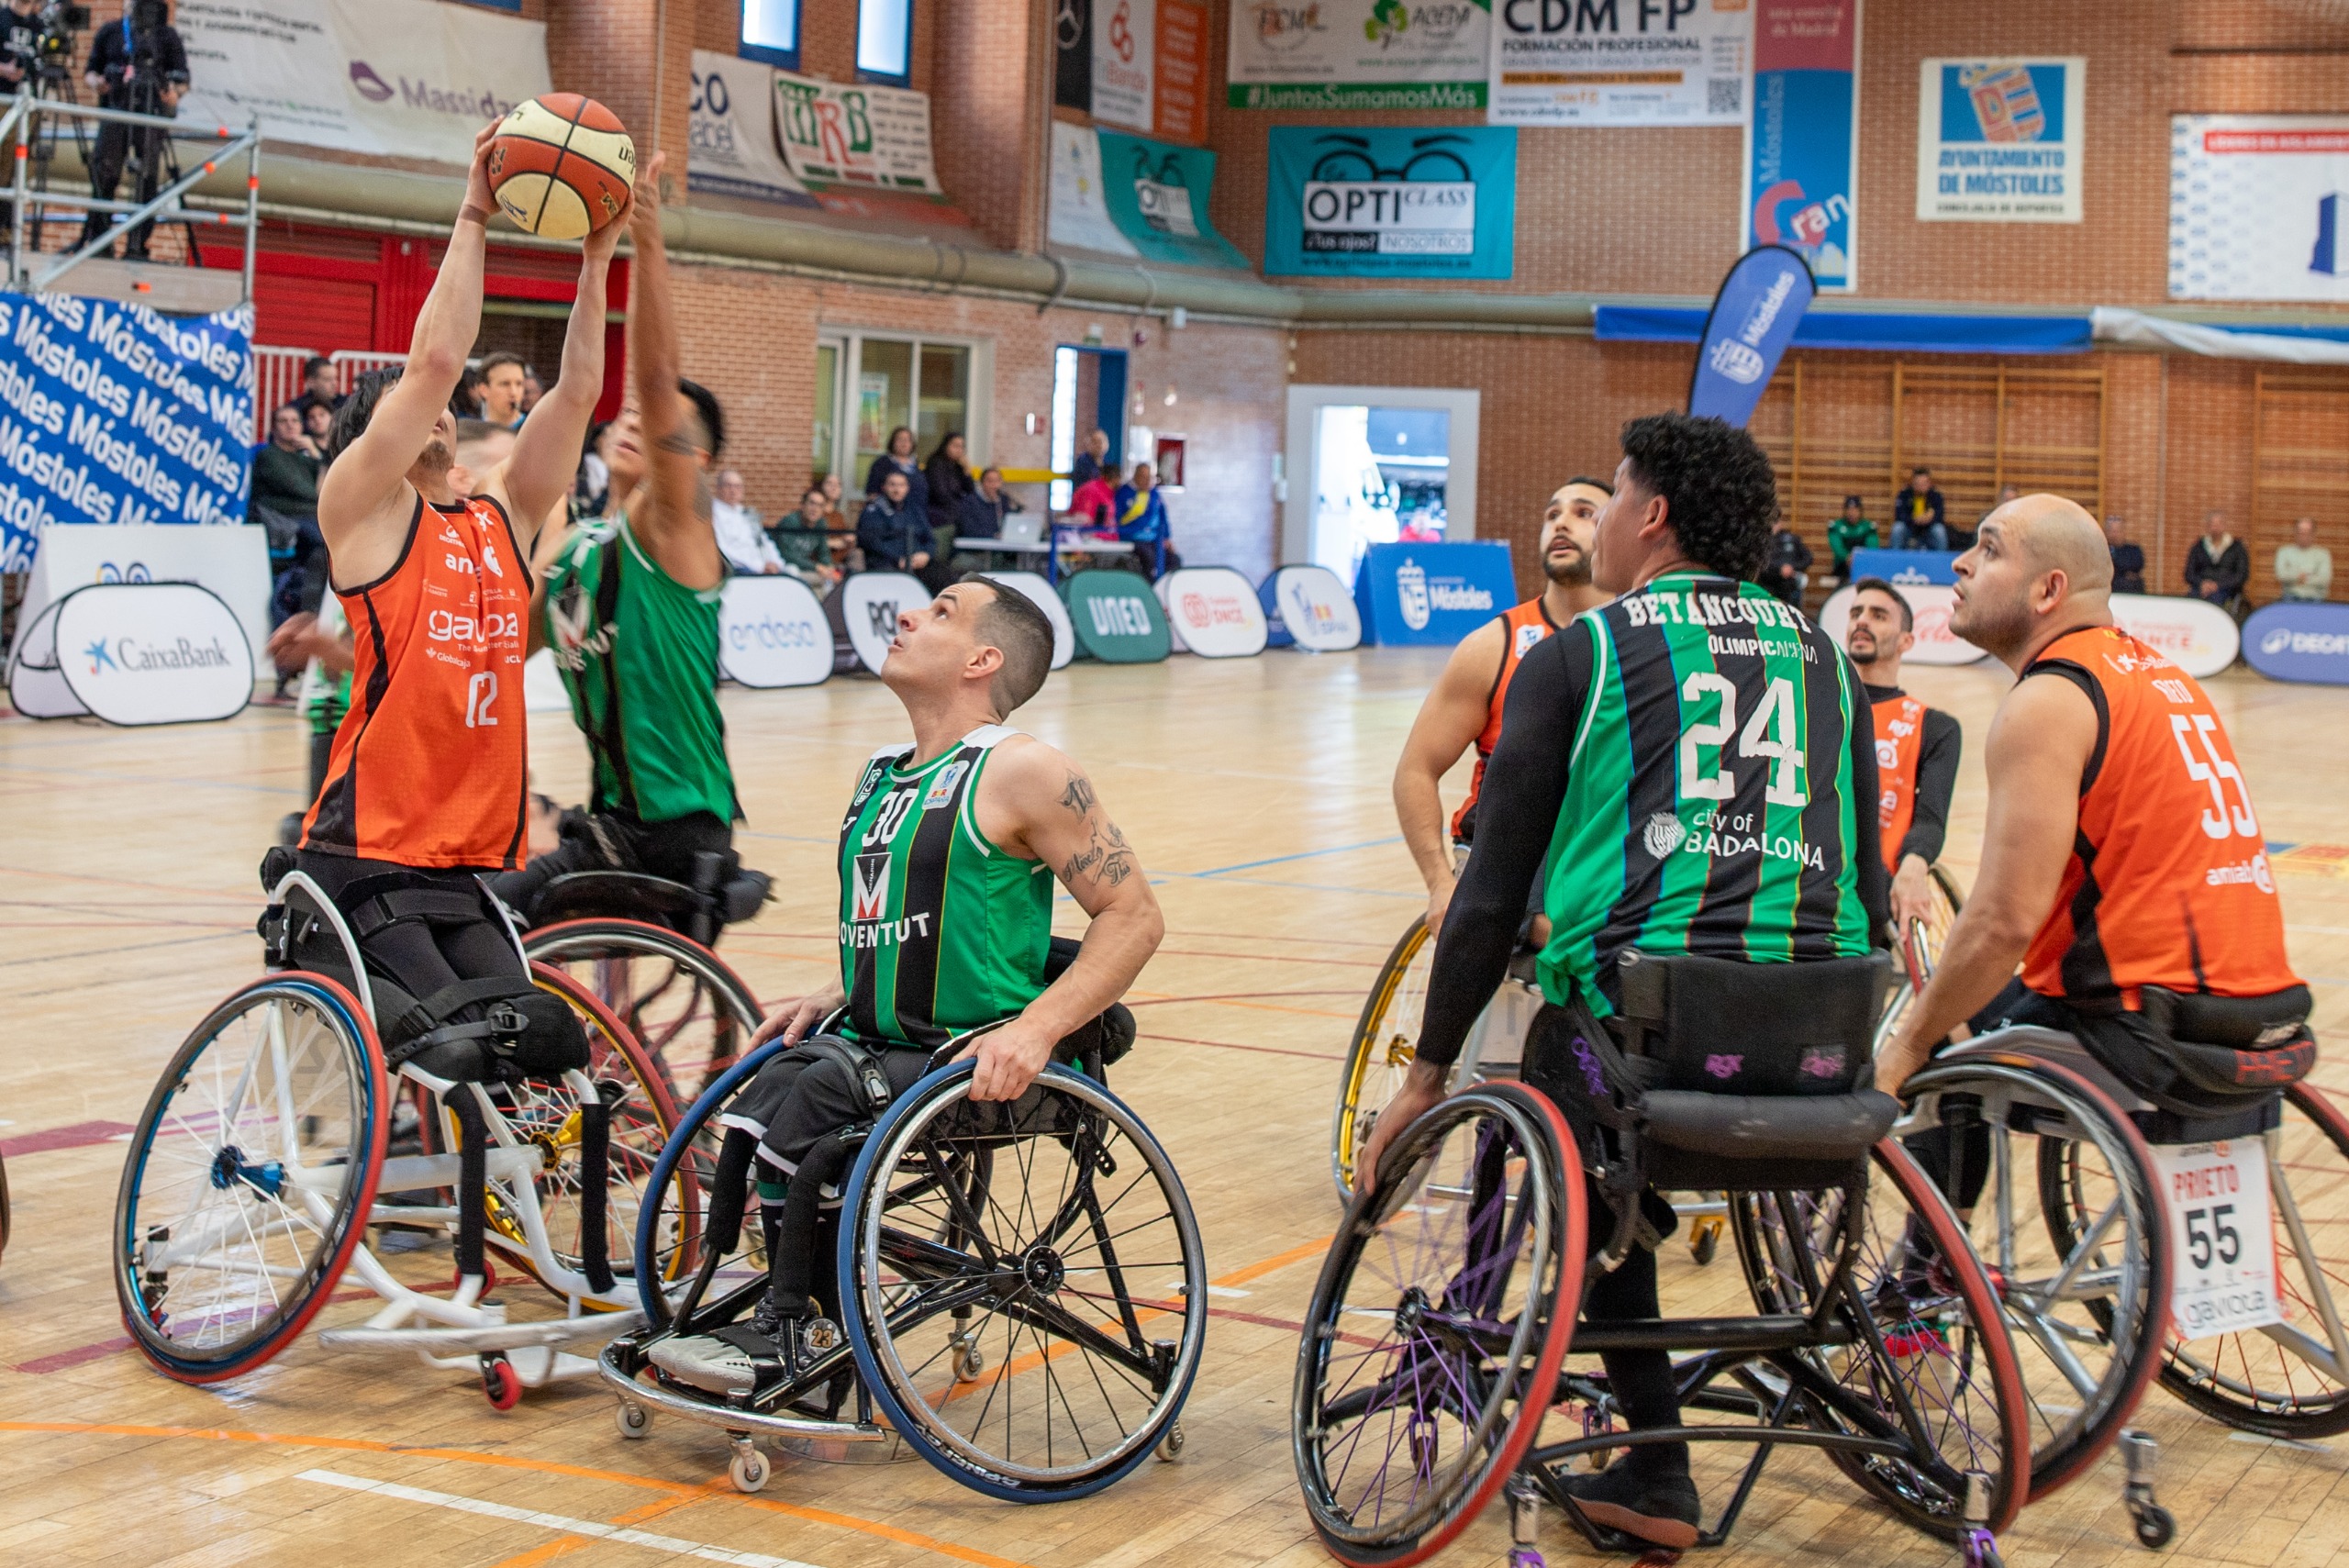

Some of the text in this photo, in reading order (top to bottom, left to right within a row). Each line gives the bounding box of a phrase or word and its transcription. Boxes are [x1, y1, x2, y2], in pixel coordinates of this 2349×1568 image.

[1503, 0, 1619, 34] CDM
[1502, 37, 1701, 53] FORMACIÓN PROFESIONAL
[1247, 83, 1477, 109] #JuntosSumamosMás
[1939, 150, 2065, 168] AYUNTAMIENTO
[1938, 170, 2065, 195] DE MÓSTOLES
[1308, 188, 1469, 224] OPTI CLASS
[1742, 271, 1797, 347] Móstoles
[14, 305, 132, 418] Móstoles
[130, 385, 242, 494] Móstoles
[0, 415, 116, 525] Móstoles
[67, 403, 183, 513] Móstoles
[1087, 595, 1152, 636] UNED
[1428, 584, 1493, 611] Móstoles
[1622, 592, 1812, 635] BETANCOURT
[729, 614, 816, 651] endesa
[117, 636, 232, 673] CaixaBank
[465, 671, 498, 728] 12
[1681, 672, 1807, 806] 24
[2168, 713, 2258, 840] 55
[862, 788, 919, 847] 30
[1693, 807, 1754, 833] city of
[1684, 830, 1826, 872] BADALONA
[840, 911, 930, 949] OVENTUT
[2172, 1163, 2241, 1204] PRIETO
[2184, 1203, 2241, 1271] 55
[811, 1328, 834, 1349] 23
